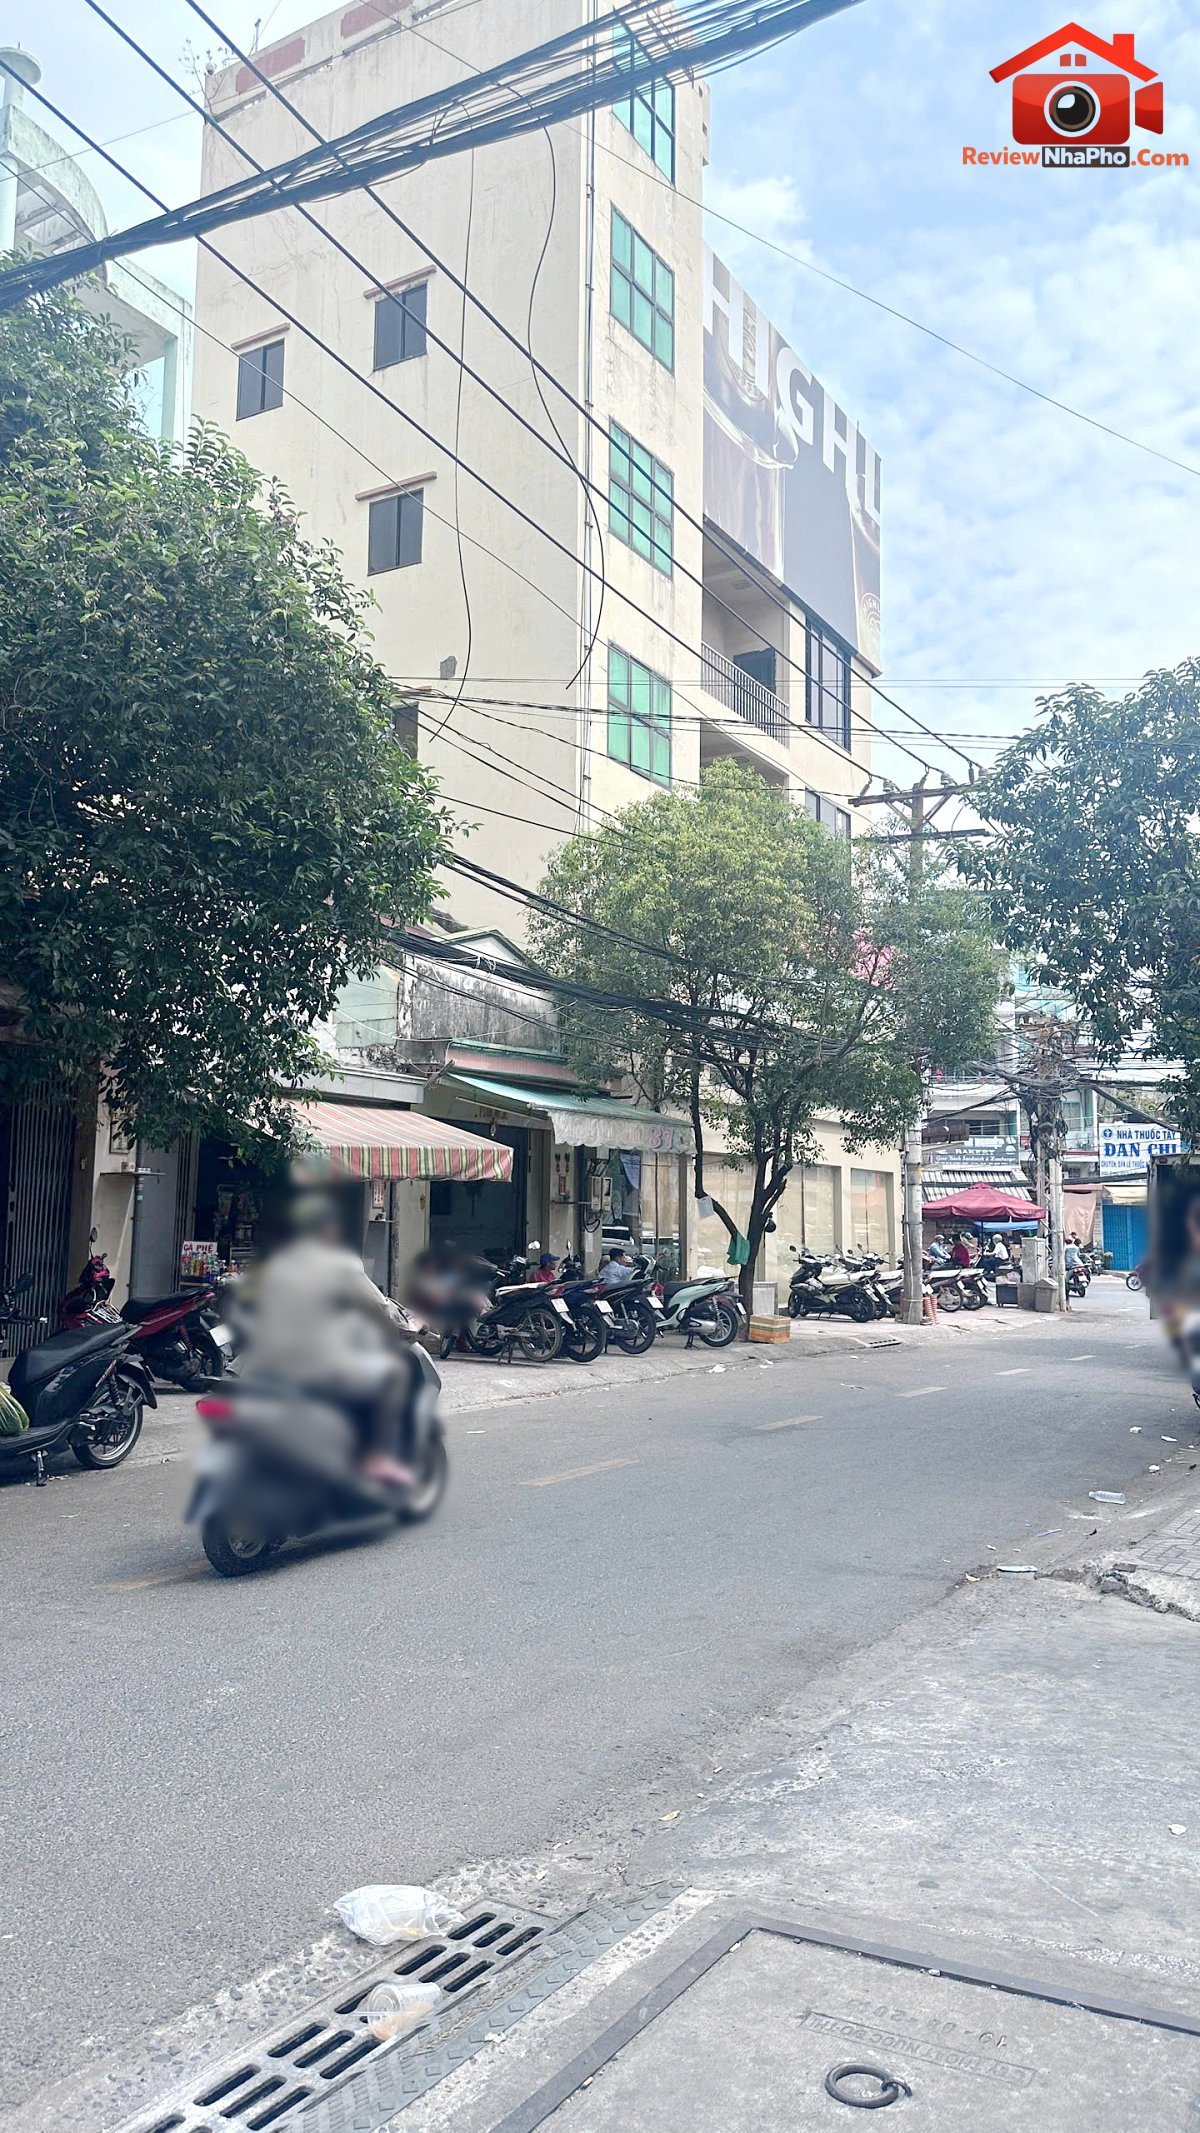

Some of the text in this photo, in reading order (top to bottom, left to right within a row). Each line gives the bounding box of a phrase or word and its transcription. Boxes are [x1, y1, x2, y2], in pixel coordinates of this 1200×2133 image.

[649, 1127, 674, 1149] 87
[1116, 1128, 1133, 1139] NHÀ
[1134, 1127, 1160, 1139] THUỐC
